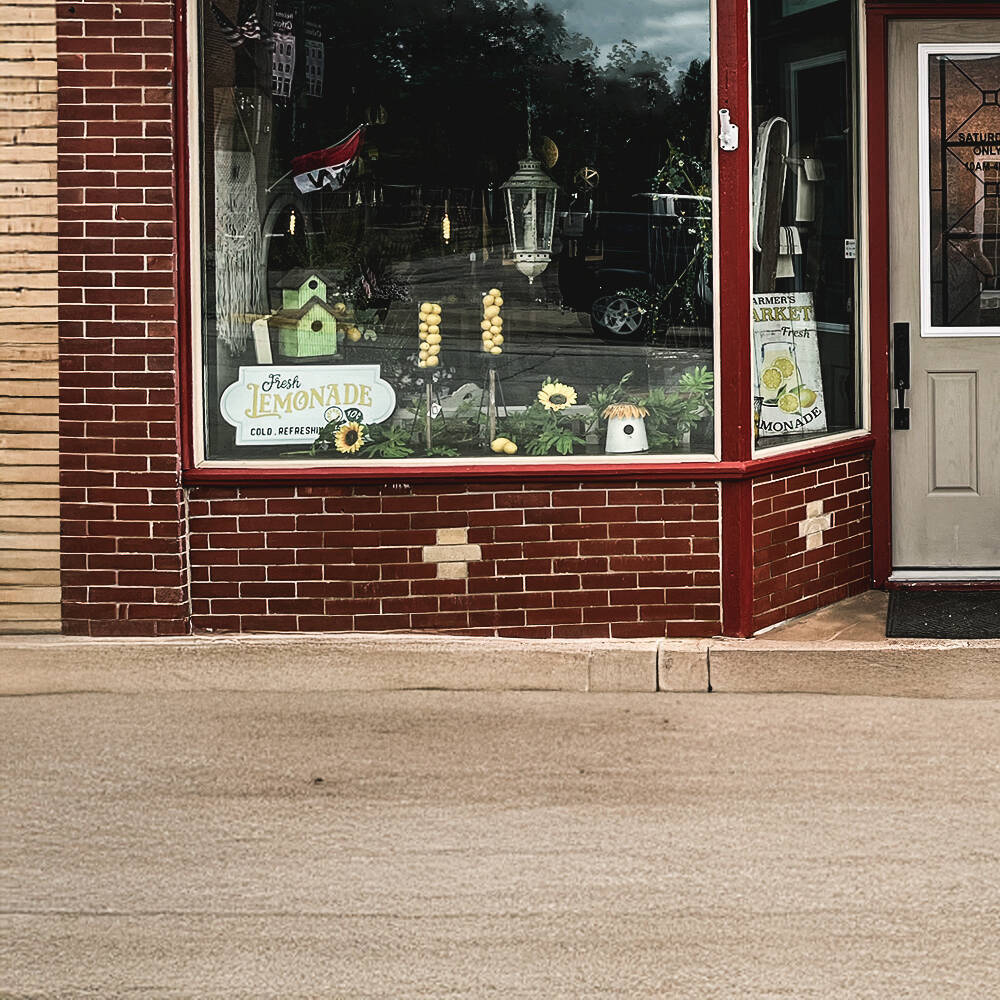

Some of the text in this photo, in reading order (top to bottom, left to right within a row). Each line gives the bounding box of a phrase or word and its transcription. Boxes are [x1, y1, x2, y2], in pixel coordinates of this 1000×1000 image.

[781, 326, 810, 339] Fresh
[262, 374, 301, 392] Fresh
[244, 383, 373, 419] LEMONADE
